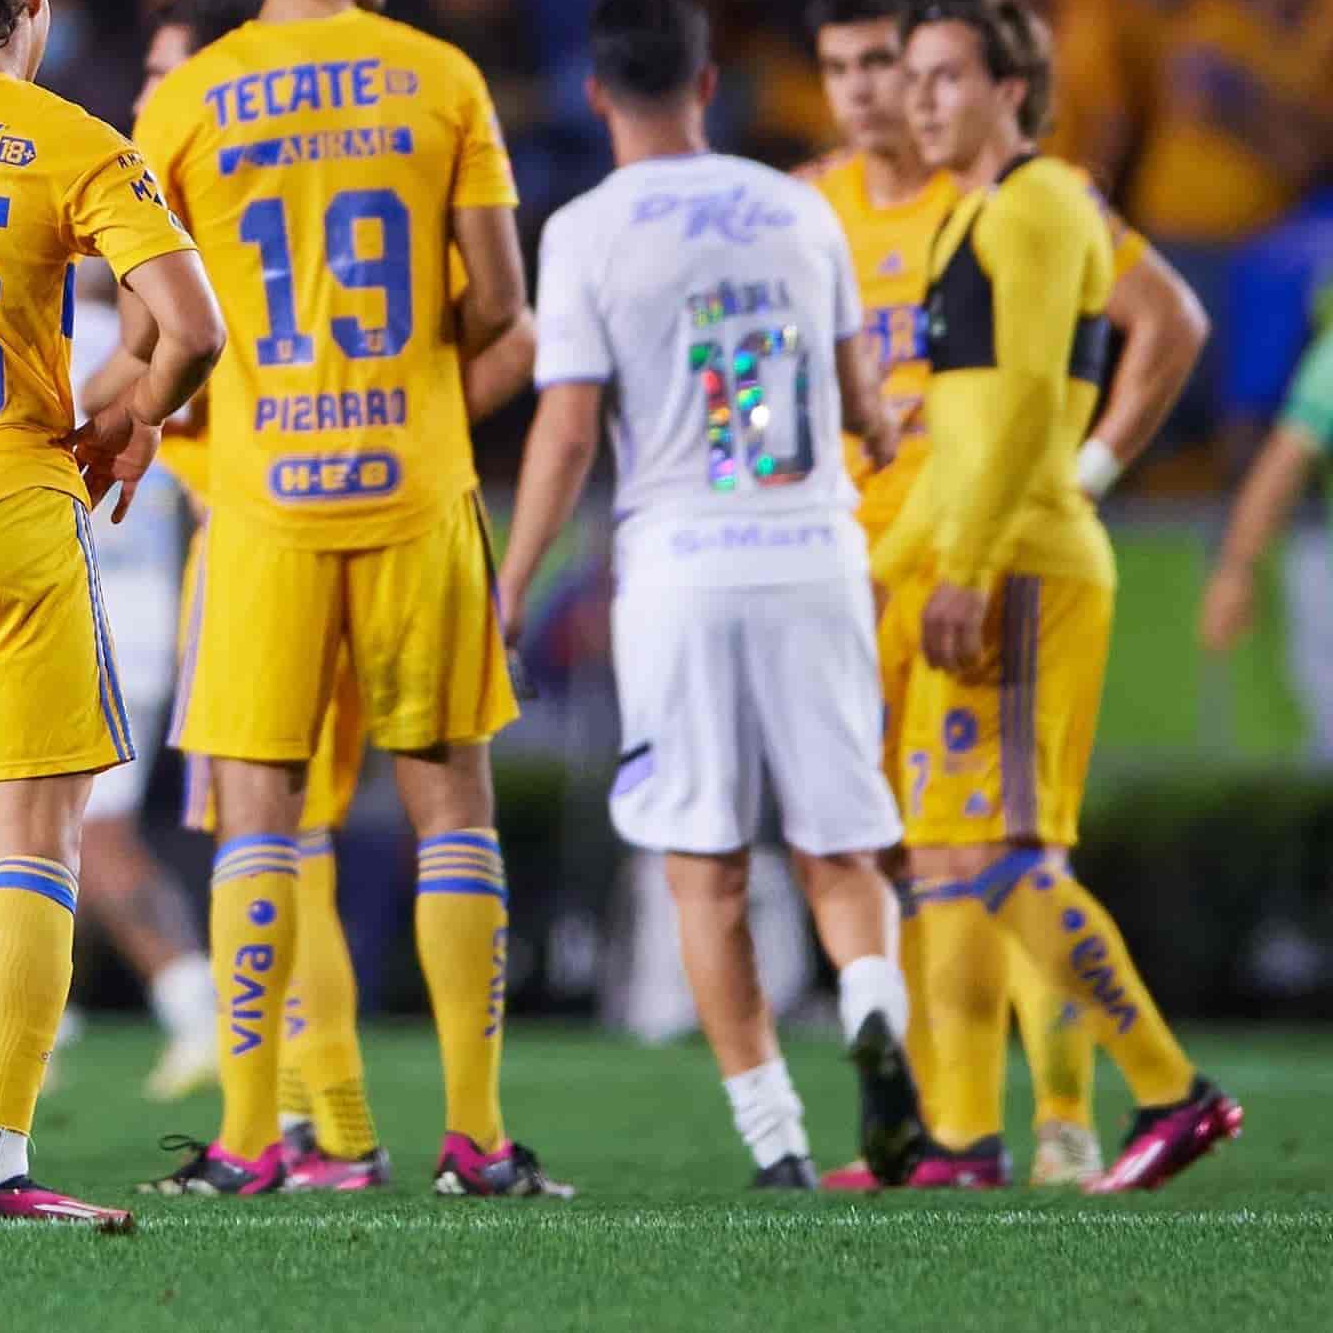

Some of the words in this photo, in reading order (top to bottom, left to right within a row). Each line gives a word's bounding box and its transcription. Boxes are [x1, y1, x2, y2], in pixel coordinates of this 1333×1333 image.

[204, 58, 381, 127] TECATE
[1, 138, 35, 165] 18+
[239, 188, 414, 366] 19
[254, 386, 406, 431] PIZARRO
[689, 324, 815, 492] 10
[231, 942, 276, 1056] viva
